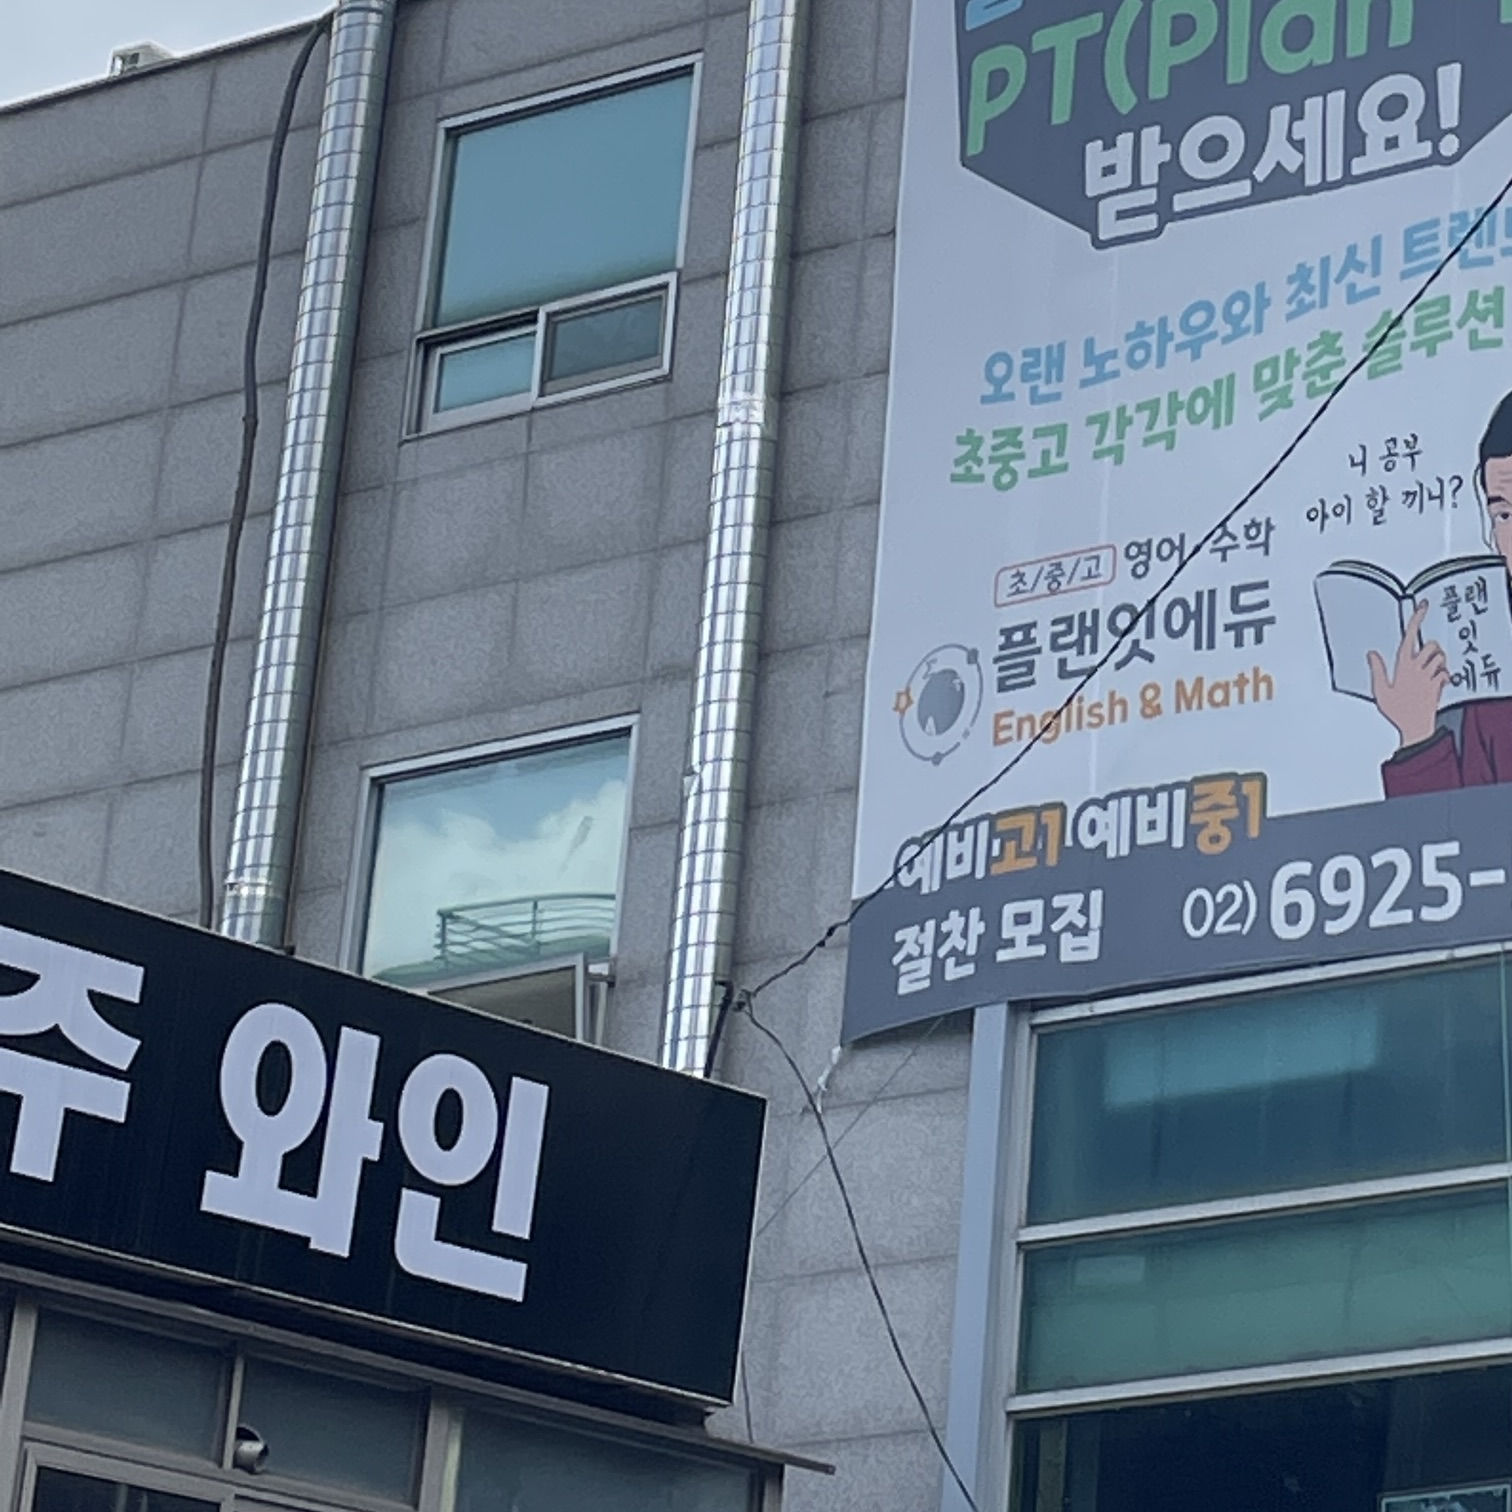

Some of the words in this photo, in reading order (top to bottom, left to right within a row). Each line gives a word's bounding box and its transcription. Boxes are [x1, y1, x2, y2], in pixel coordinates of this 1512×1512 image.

[1084, 63, 1462, 241] 받으세요!
[981, 339, 1066, 406] 오랜
[1080, 282, 1273, 388] 노하우와
[1285, 236, 1383, 319] 최신
[950, 423, 1068, 493] 초중고
[1084, 374, 1235, 465] 각각에
[1252, 331, 1346, 417] 맞춘
[1361, 287, 1505, 380] 솔루션
[1306, 495, 1351, 534] 아이
[1366, 485, 1388, 526] 할
[1348, 445, 1366, 476] 니
[1379, 433, 1423, 473] 공부
[993, 581, 1276, 693] 플랜잇에듀
[993, 690, 1128, 746] English
[1139, 681, 1163, 719] &
[1175, 666, 1273, 715] Math
[896, 808, 1062, 894] 예비고1
[1077, 778, 1262, 859] 예비중1
[892, 907, 985, 995] 절찬
[996, 889, 1103, 963] 모집
[200, 1001, 549, 1302] 와인
